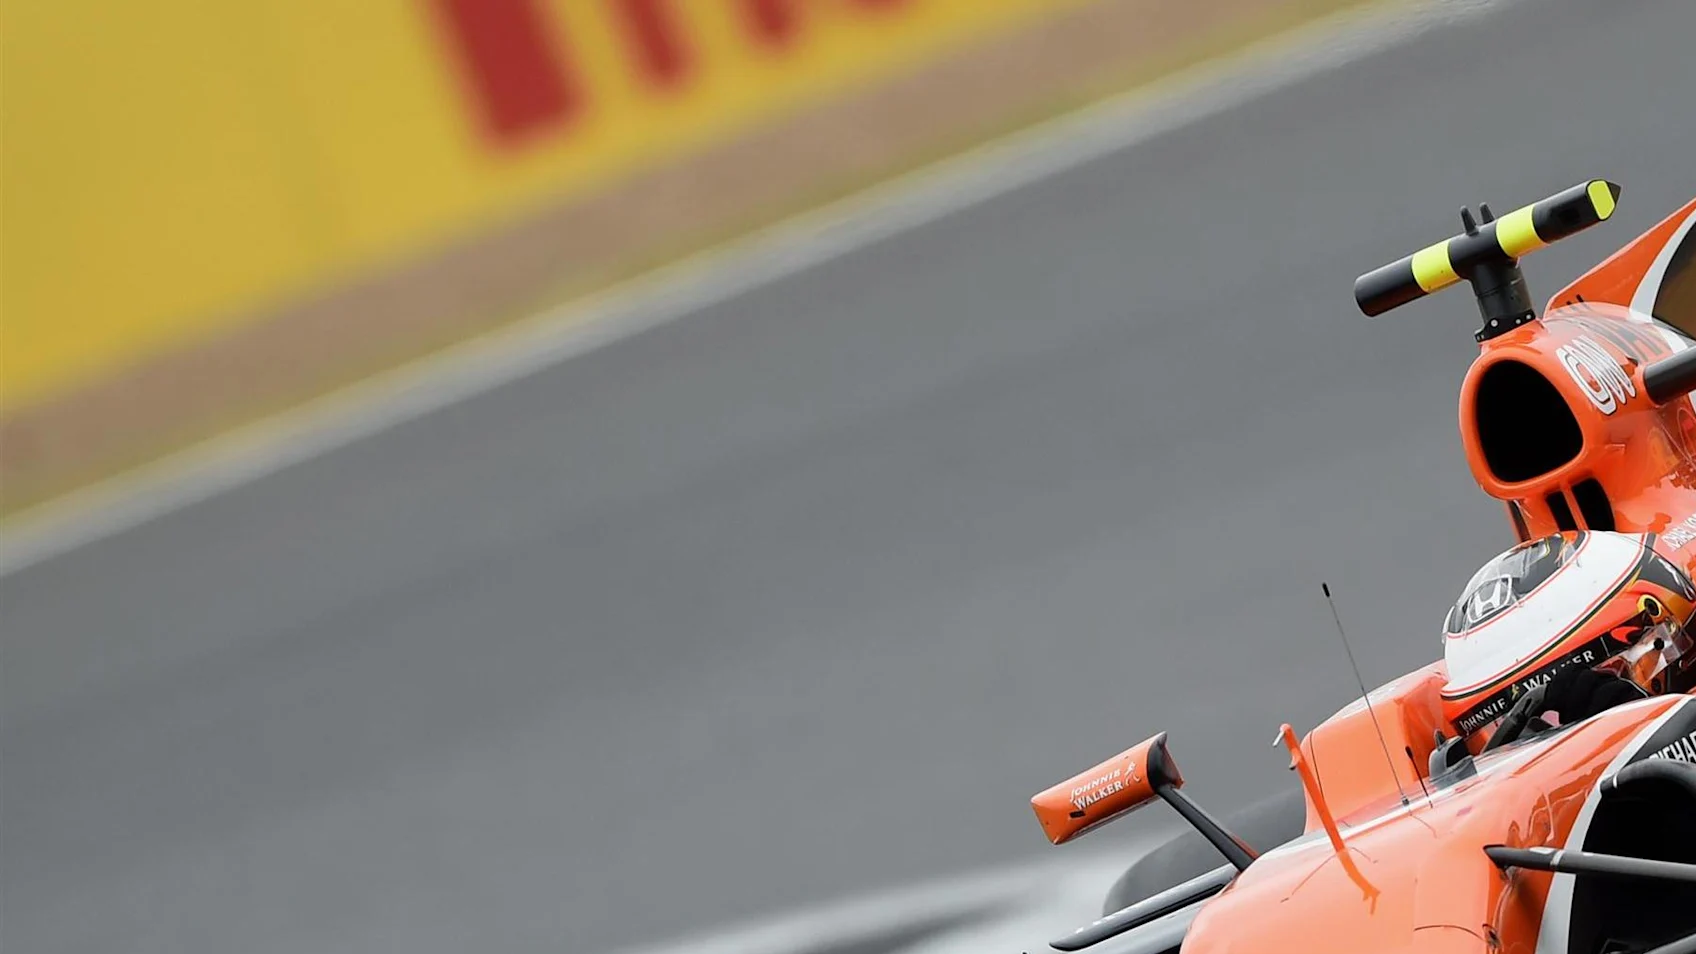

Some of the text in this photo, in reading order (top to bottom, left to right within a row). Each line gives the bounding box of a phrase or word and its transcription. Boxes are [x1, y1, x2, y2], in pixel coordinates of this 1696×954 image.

[1522, 650, 1596, 692] WAER
[1069, 768, 1121, 803] JOHNNIE
[1072, 780, 1124, 811] WALKER
